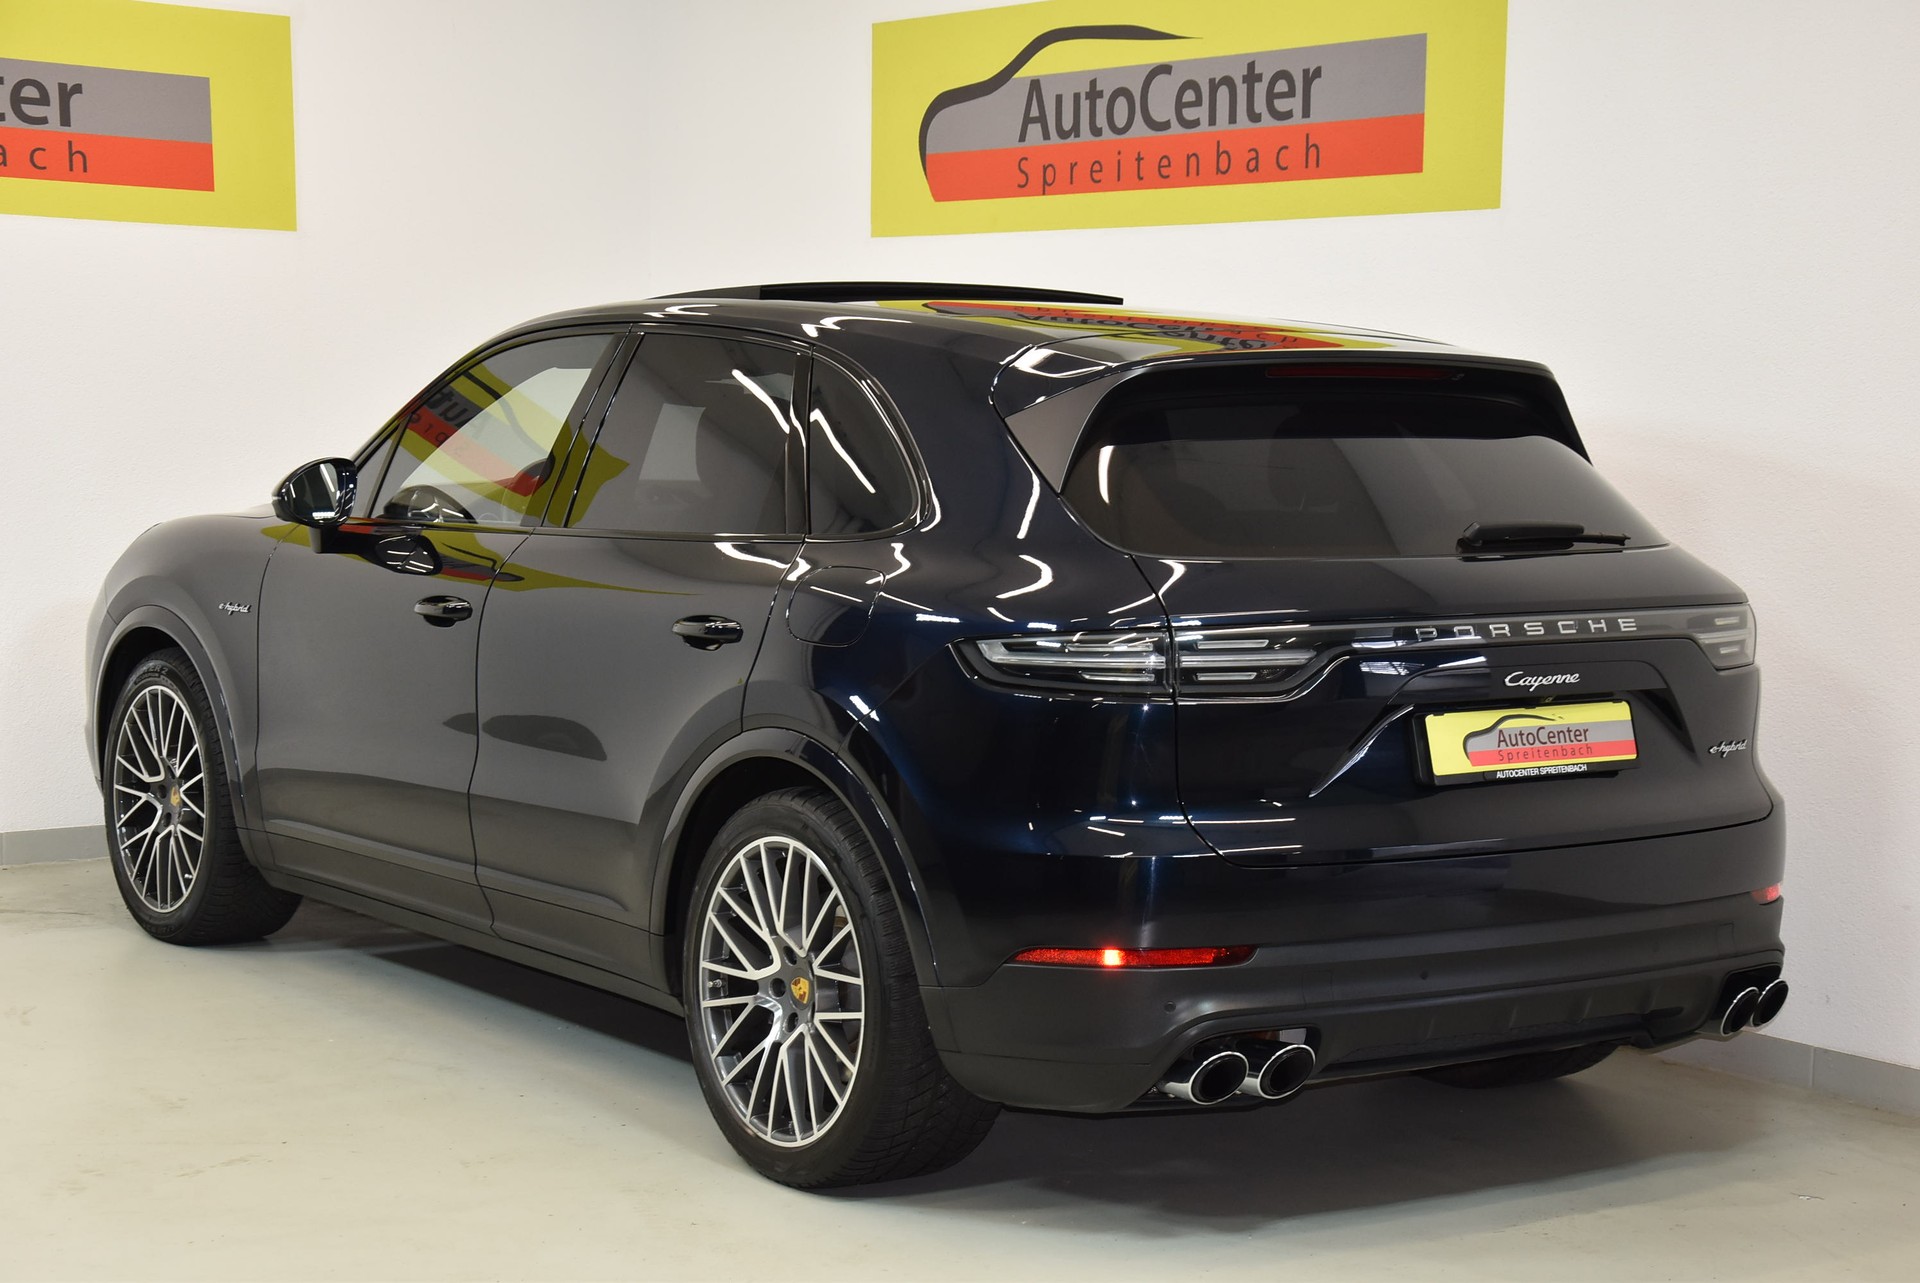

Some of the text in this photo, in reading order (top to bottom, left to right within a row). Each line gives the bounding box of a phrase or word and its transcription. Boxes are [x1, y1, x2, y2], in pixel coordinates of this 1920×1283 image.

[0, 76, 83, 127] er
[1018, 60, 1322, 143] AutoCenter
[1017, 133, 1320, 195] Spreitenbach
[1415, 618, 1637, 641] PORSCHE
[1504, 671, 1581, 692] Cayenne
[1497, 726, 1589, 748] AutoCenter
[1497, 744, 1593, 763] Spreitenbach
[1496, 763, 1588, 779] AUTOCENTER SPREITENBACH
